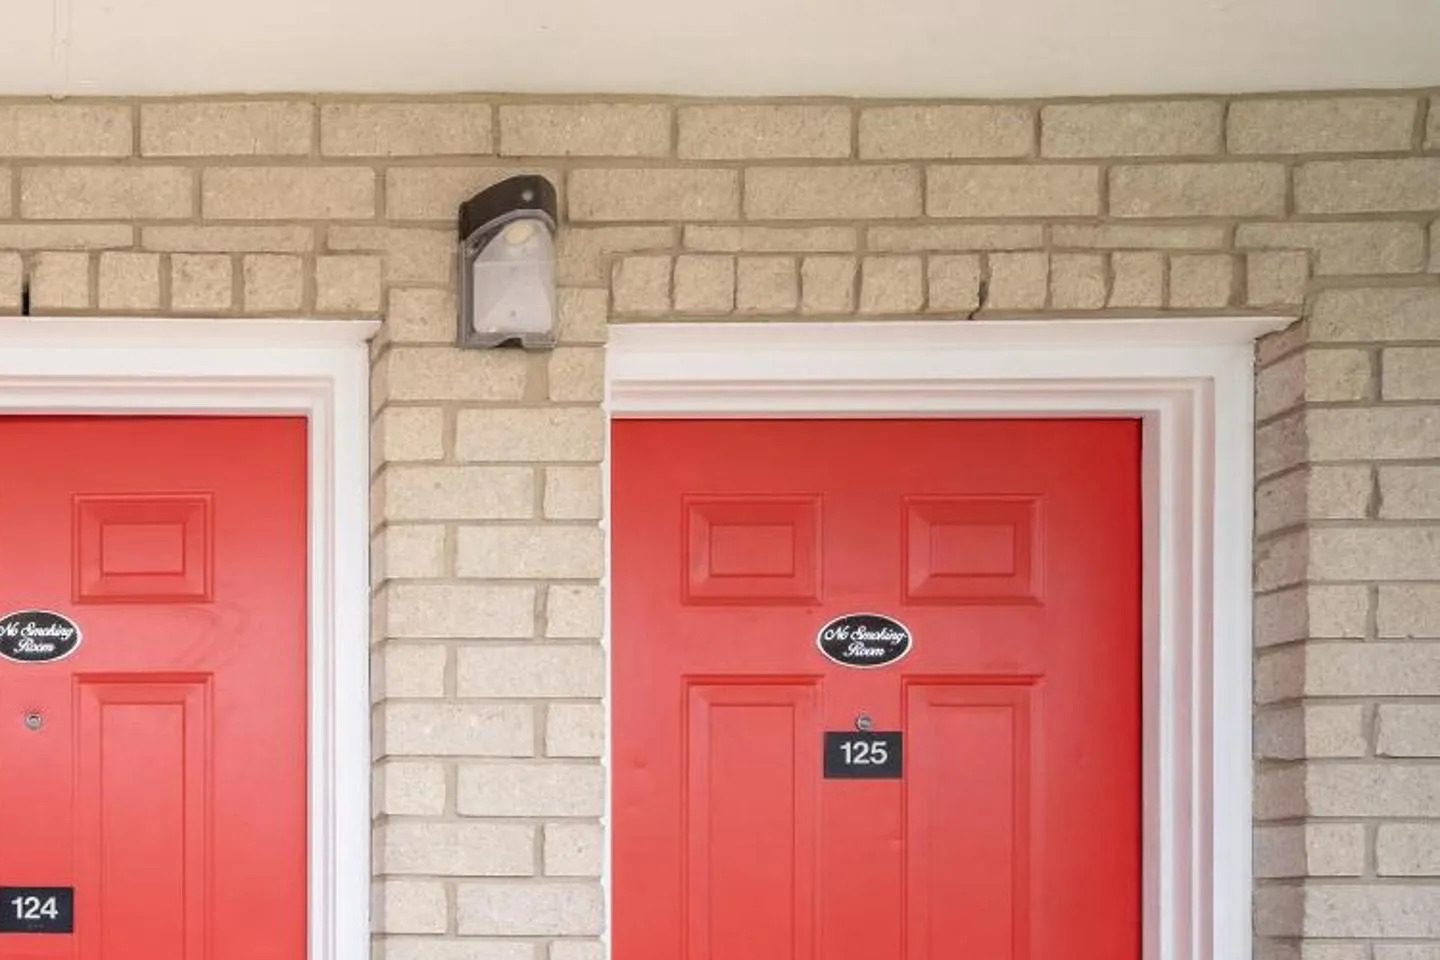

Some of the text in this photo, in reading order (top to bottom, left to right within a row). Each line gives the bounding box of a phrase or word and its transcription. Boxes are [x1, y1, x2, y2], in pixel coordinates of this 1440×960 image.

[20, 621, 74, 641] Smoking
[824, 625, 907, 645] No Smoking
[13, 637, 55, 653] Room
[842, 641, 885, 657] Room
[840, 741, 888, 765] 125
[11, 896, 59, 919] 124
